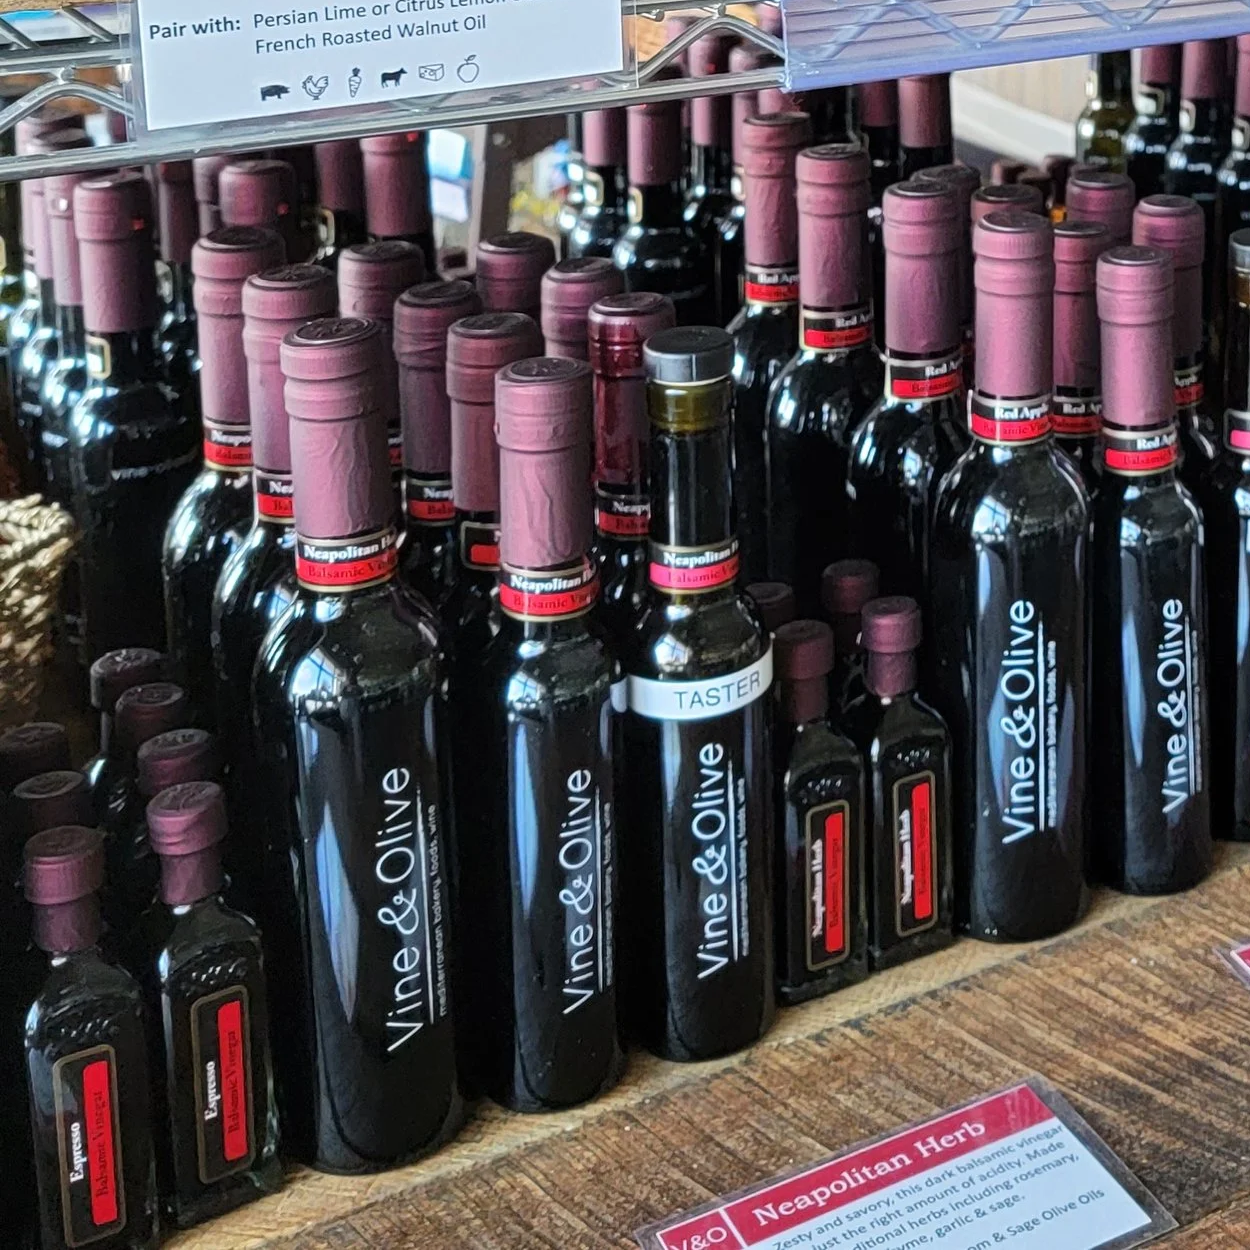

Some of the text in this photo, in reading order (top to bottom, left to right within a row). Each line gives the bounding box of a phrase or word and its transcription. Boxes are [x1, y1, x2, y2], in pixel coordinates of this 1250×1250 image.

[149, 16, 240, 39] Pair with:
[253, 9, 318, 28] Persian
[324, 5, 366, 21] Lime
[371, 3, 390, 16] or
[255, 14, 486, 54] French Roasted Walnut Oil
[304, 543, 379, 563] Neapolitan
[674, 669, 760, 710] TASTER
[375, 767, 424, 1051] Vine & Olive
[205, 1060, 221, 1121] Espresso
[70, 1122, 87, 1183] Espresso
[751, 1122, 985, 1226] Neapolitan Herb
[772, 1125, 1063, 1250] Zesty and savory, this dark balsamic vinegar
[841, 1226, 867, 1240] the
[869, 1209, 904, 1229] right
[905, 1185, 960, 1213] amount
[961, 1175, 976, 1189] of
[978, 1158, 1022, 1182] acidity.
[1025, 1141, 1064, 1161] Made
[852, 1153, 1079, 1250] ditional herbs including rosemary,
[934, 1215, 973, 1238] garlic
[974, 1208, 987, 1218] &
[988, 1194, 1025, 1212] sage.
[992, 1189, 1105, 1243] & Sage Olive Oils
